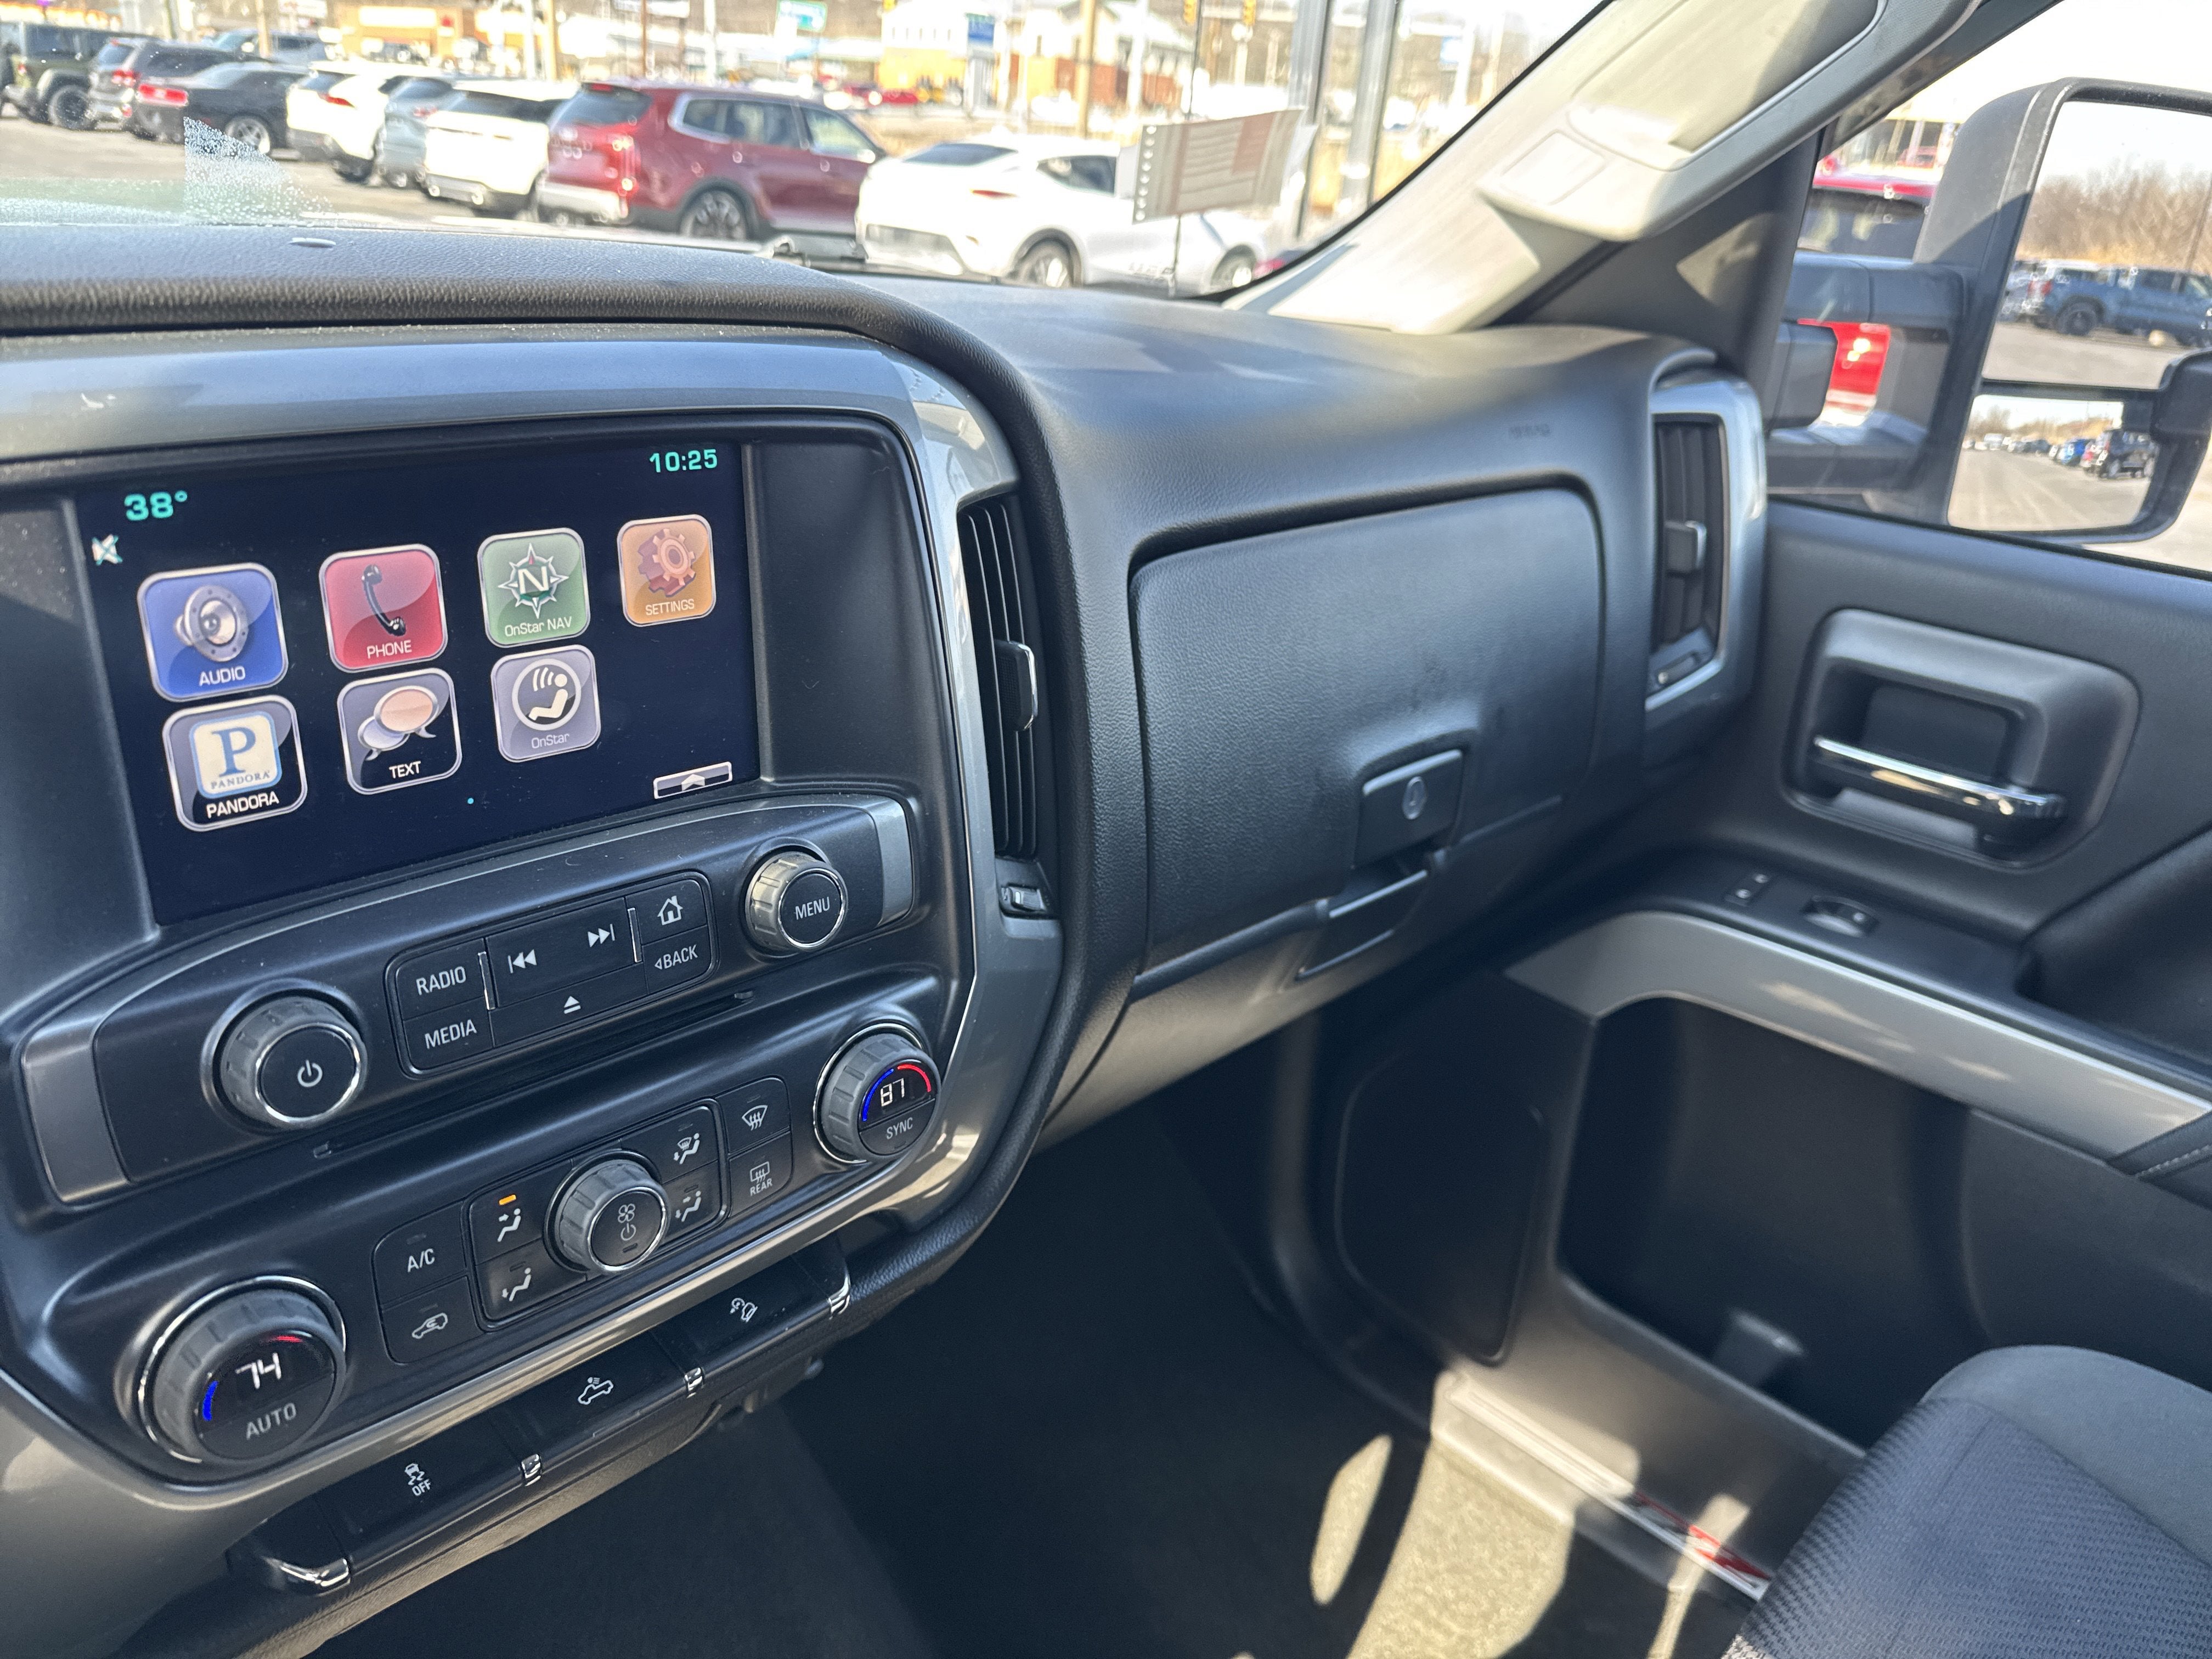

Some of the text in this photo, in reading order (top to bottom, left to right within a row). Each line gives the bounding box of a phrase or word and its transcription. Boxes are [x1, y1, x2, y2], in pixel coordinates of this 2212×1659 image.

[650, 449, 718, 472] 10:25
[125, 491, 187, 520] 38°
[518, 566, 548, 594] N
[645, 599, 695, 616] SETTINGS
[505, 617, 572, 637] OnStar NAV
[366, 640, 412, 659] PHONE
[199, 666, 246, 687] AUDIO
[211, 727, 256, 778] P
[531, 732, 570, 749] OnStar
[211, 770, 270, 789] PANDORA
[389, 761, 421, 779] TEXT
[206, 791, 280, 819] PANDORA
[795, 896, 831, 920] MENU
[663, 944, 698, 968] BACK
[416, 966, 467, 996] RADIO
[425, 1019, 477, 1049] MEDIA
[880, 1078, 905, 1107] 87
[886, 1117, 913, 1139] SYNC
[750, 1177, 773, 1196] REAR
[407, 1248, 435, 1272] A/C
[235, 1352, 281, 1389] 74
[246, 1402, 297, 1440] AUTO
[411, 1479, 431, 1496] OFF
